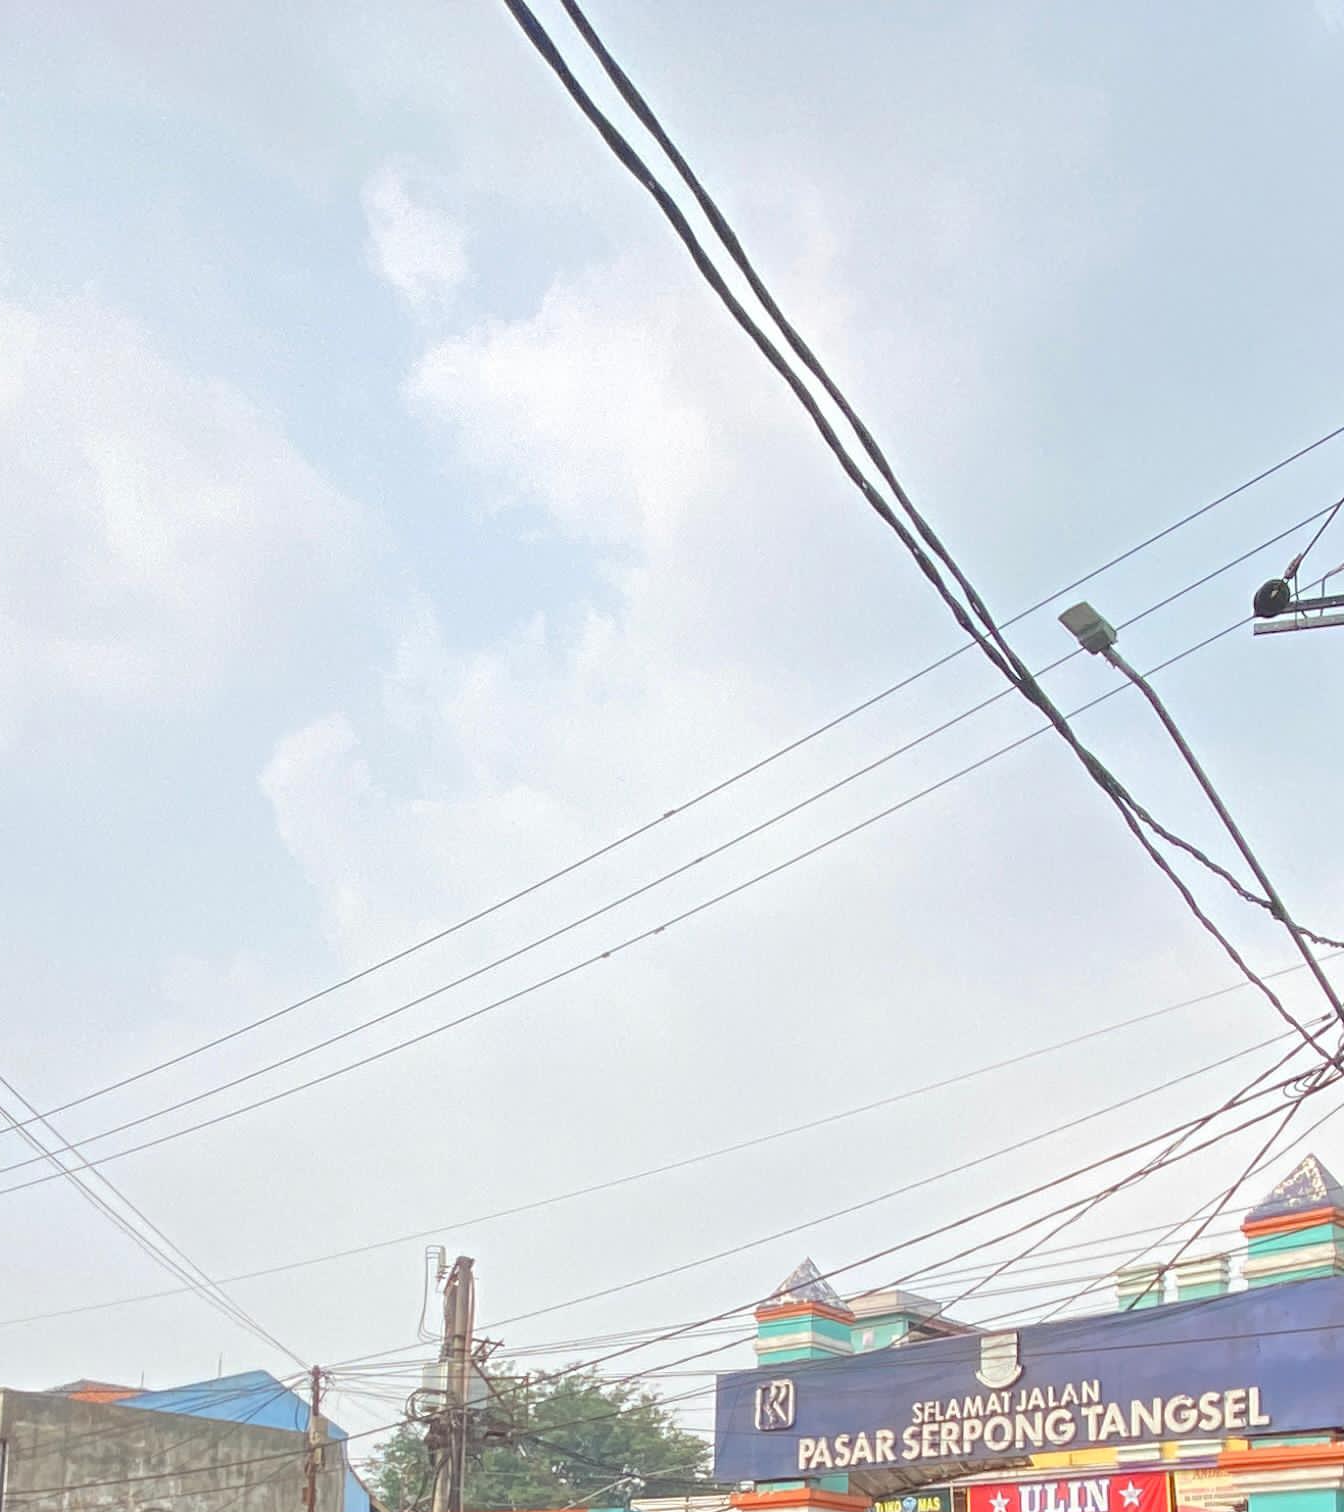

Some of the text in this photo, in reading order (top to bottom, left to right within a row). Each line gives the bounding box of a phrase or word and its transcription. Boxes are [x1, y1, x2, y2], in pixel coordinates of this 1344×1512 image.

[911, 1379, 1101, 1424] SELAMAT JALAN
[798, 1386, 1270, 1471] PASAR SERPONG TANGSEL
[918, 1497, 941, 1512] MAS
